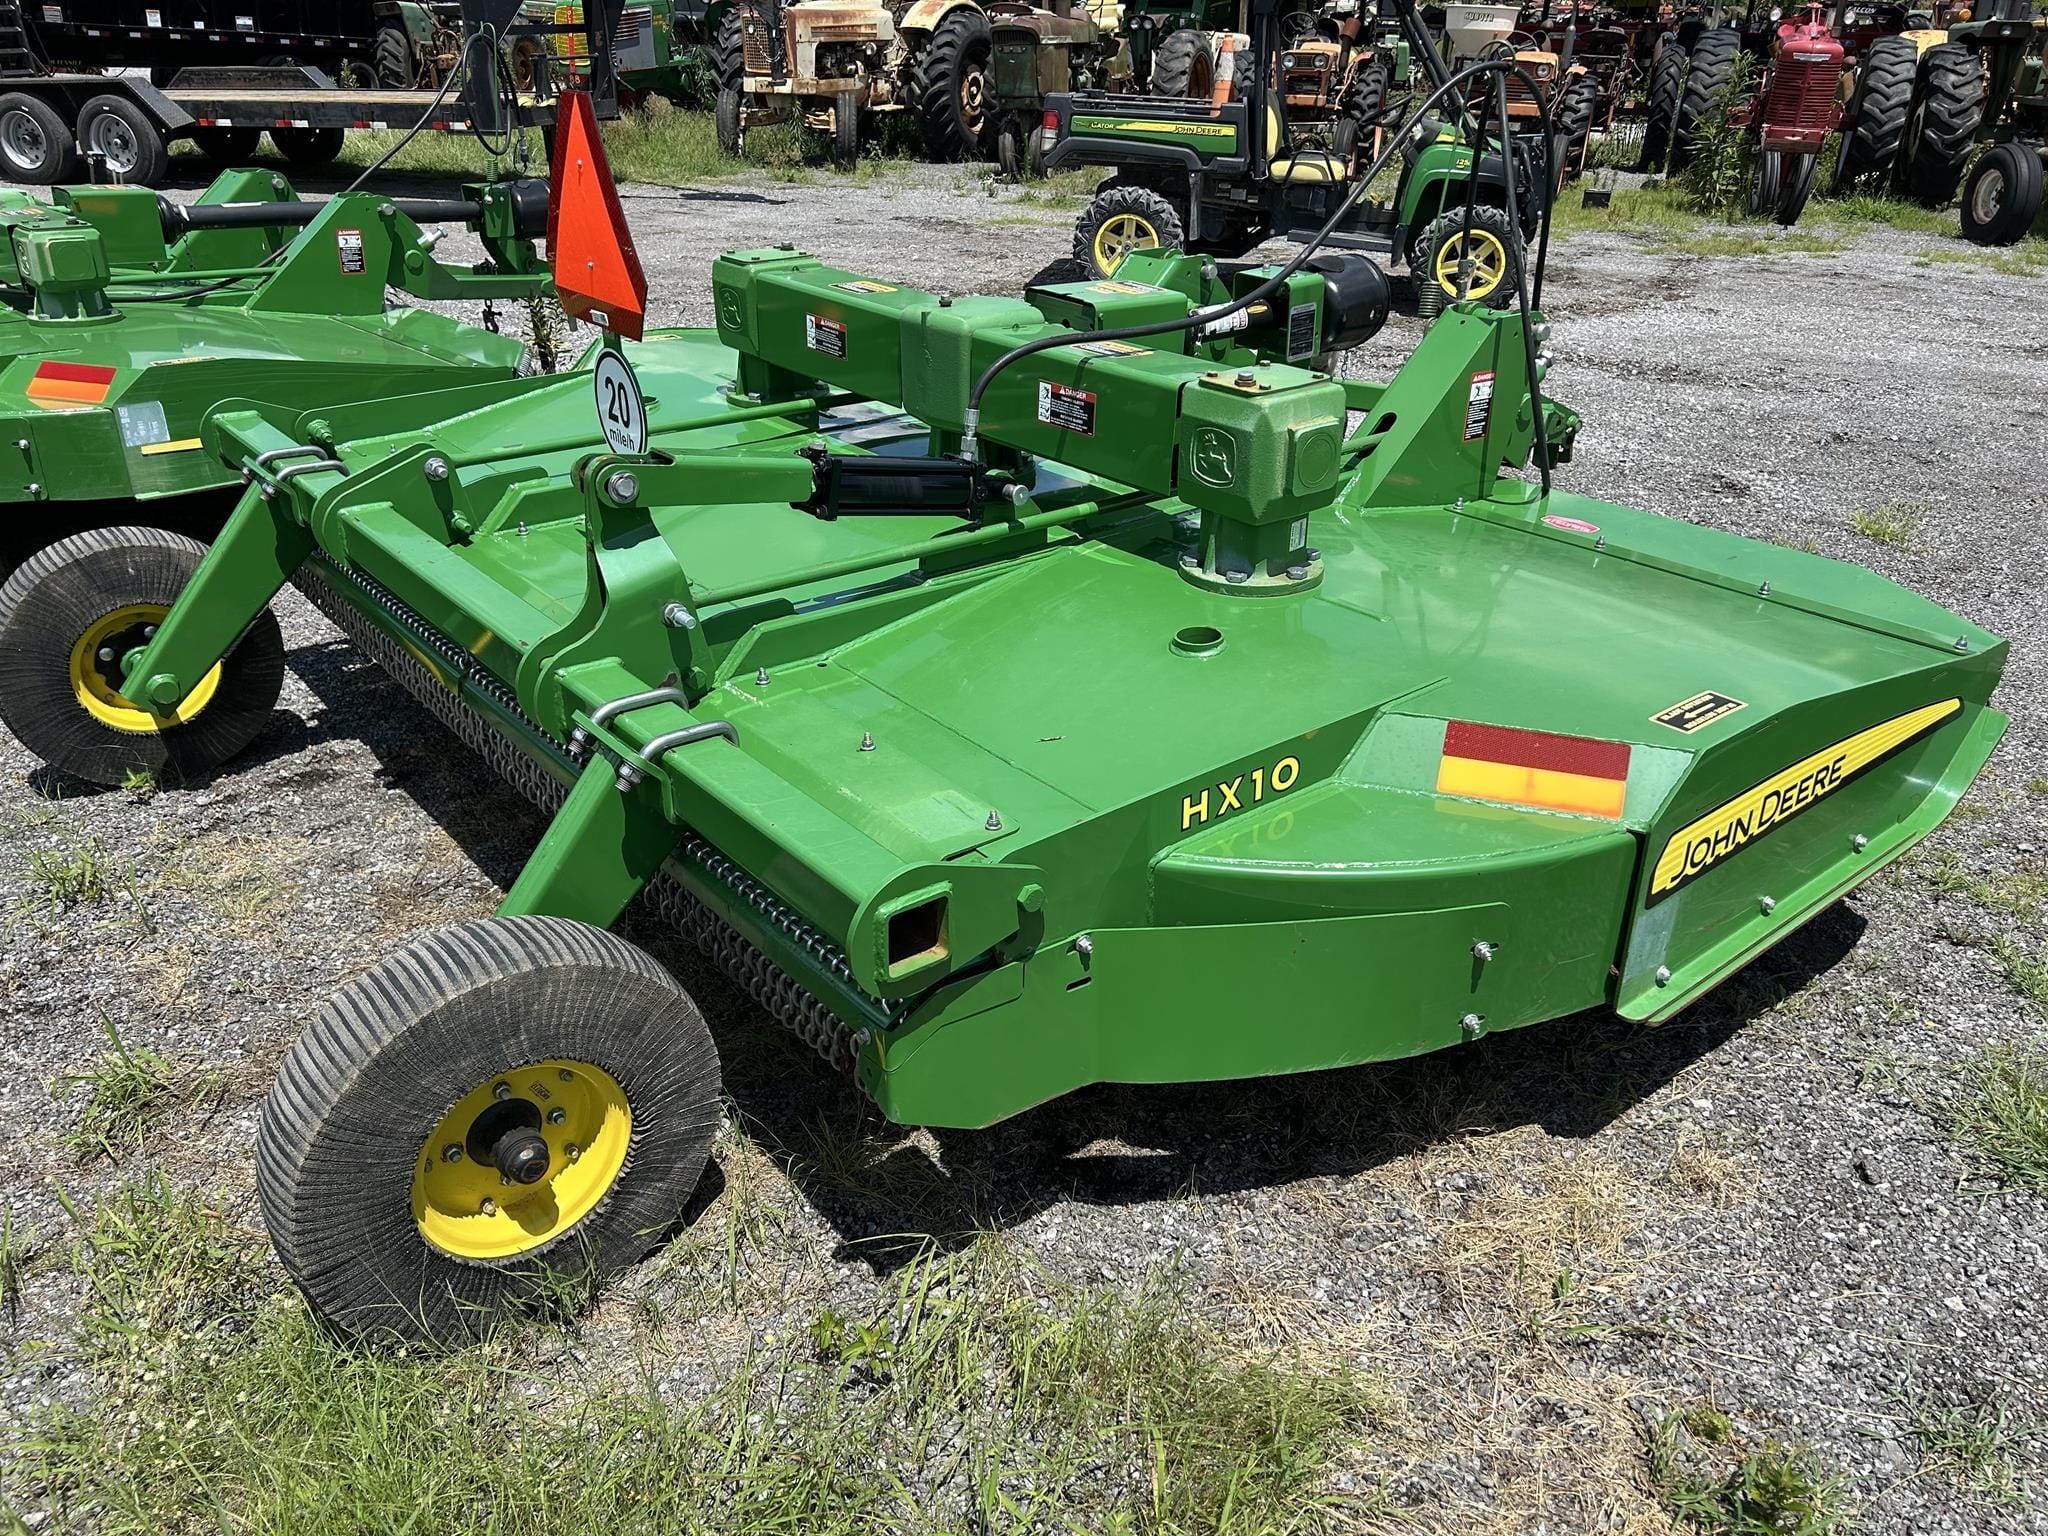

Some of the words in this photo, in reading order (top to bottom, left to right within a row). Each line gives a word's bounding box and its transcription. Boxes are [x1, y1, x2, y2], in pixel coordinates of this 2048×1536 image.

[1464, 12, 1494, 22] KUBOTA
[1091, 121, 1114, 129] GATOR
[1173, 125, 1195, 134] JOHN
[1196, 126, 1222, 135] DEERE
[604, 376, 630, 429] 20
[1065, 388, 1087, 400] DANGER
[609, 428, 635, 452] mile/h
[1181, 755, 1300, 832] HX10
[1669, 809, 1755, 884] JOHN
[1757, 754, 1847, 826] DEERE
